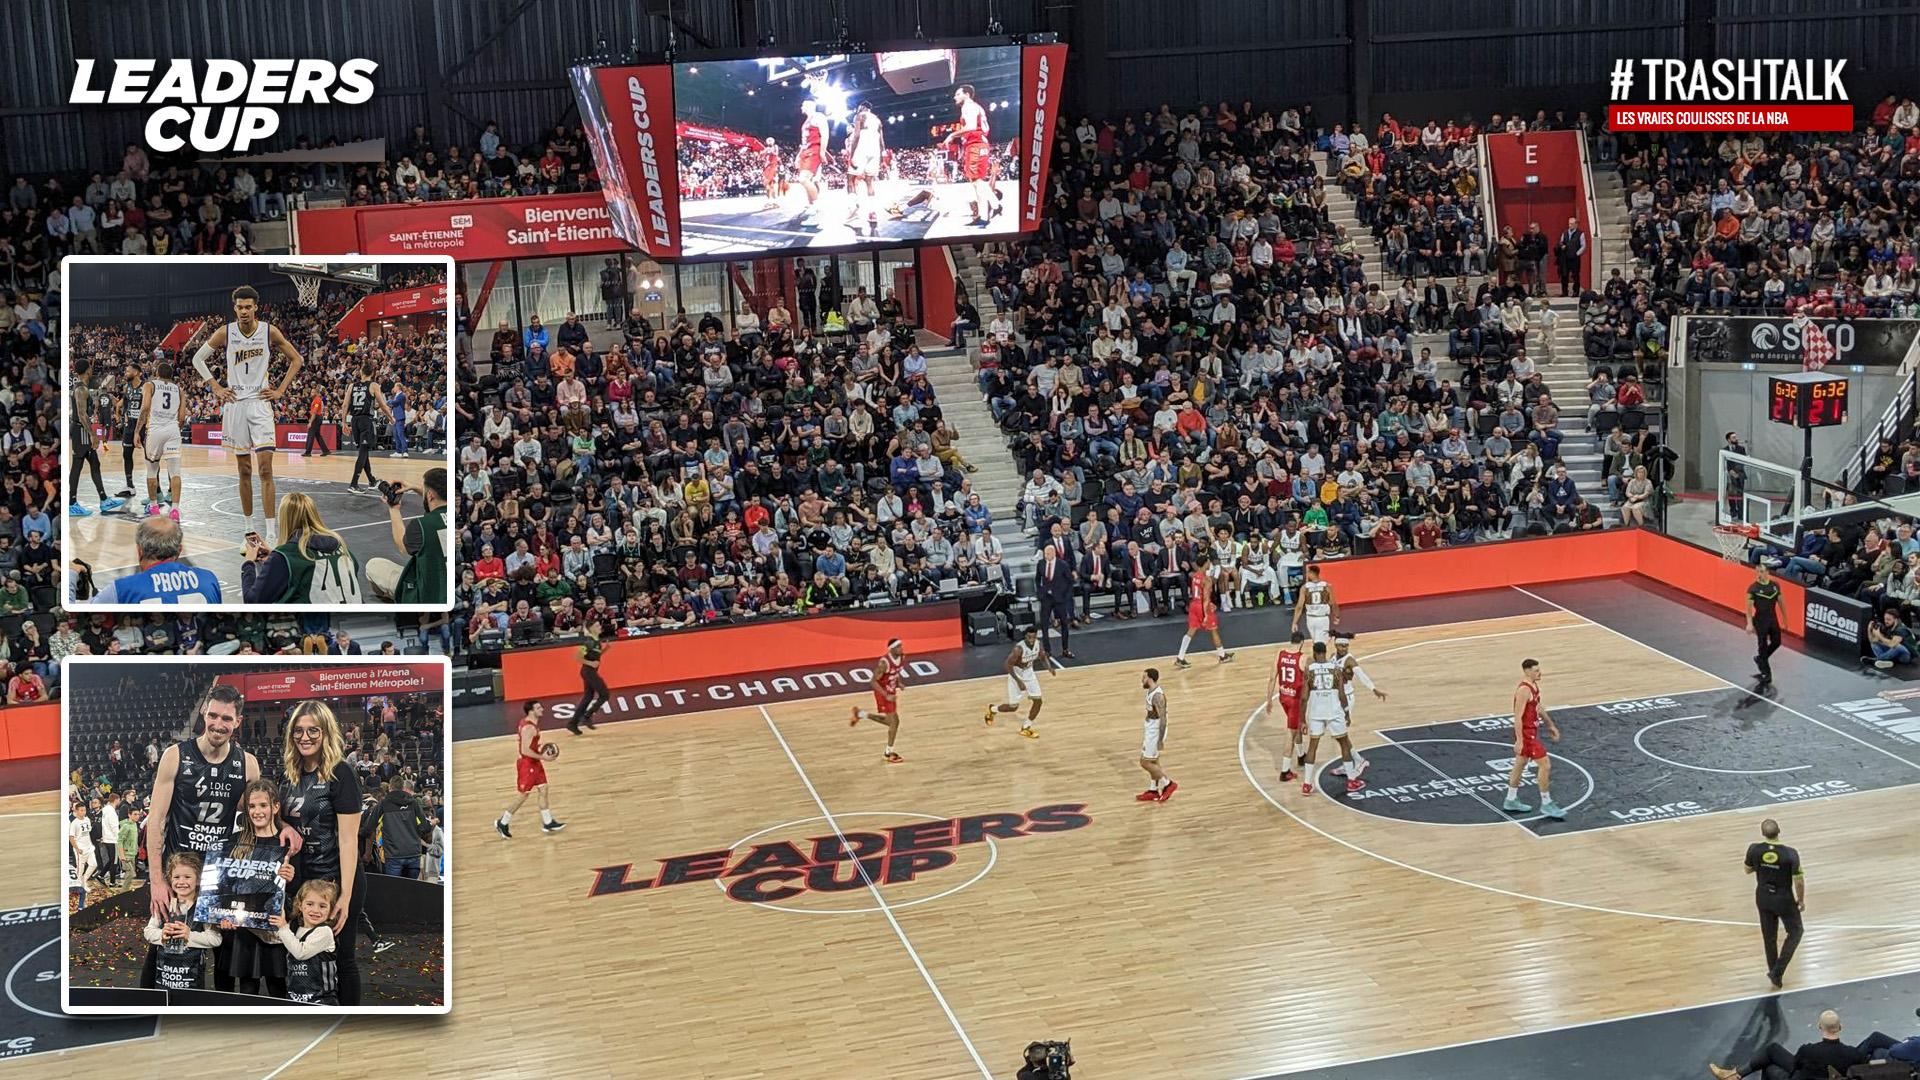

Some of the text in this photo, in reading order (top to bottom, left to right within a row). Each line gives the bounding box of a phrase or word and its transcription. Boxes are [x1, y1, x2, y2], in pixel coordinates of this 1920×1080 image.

[1026, 55, 1050, 221] LEADERS CUP
[628, 76, 671, 247] LEADERS CUP
[1525, 145, 1538, 164] E
[389, 230, 464, 242] SAINT-ÉTIENNE
[403, 239, 464, 250] la métropole
[245, 362, 249, 375] 1
[1776, 382, 1798, 398] 6:32
[1813, 382, 1846, 398] 6:32
[162, 393, 171, 409] 3
[352, 391, 367, 406] 12
[151, 570, 199, 593] PHOTO
[1806, 602, 1858, 633] SiliGom
[319, 669, 410, 681] Bienvenue à l'Arena
[1281, 667, 1296, 683] 13
[310, 681, 367, 692] Saint-Étienne
[1596, 697, 1676, 712] Loire
[1761, 780, 1850, 798] Loire
[1389, 795, 1416, 804] la
[198, 801, 224, 823] 12
[1609, 801, 1701, 819] Loire
[194, 824, 227, 834] SMART
[587, 802, 1094, 898] LEADERS
[214, 857, 278, 872] LEADERS
[227, 867, 256, 880] CUP
[725, 848, 958, 904] CUP
[161, 971, 182, 981] GOOD
[163, 965, 190, 974] SMART
[162, 978, 190, 988] THINGS
